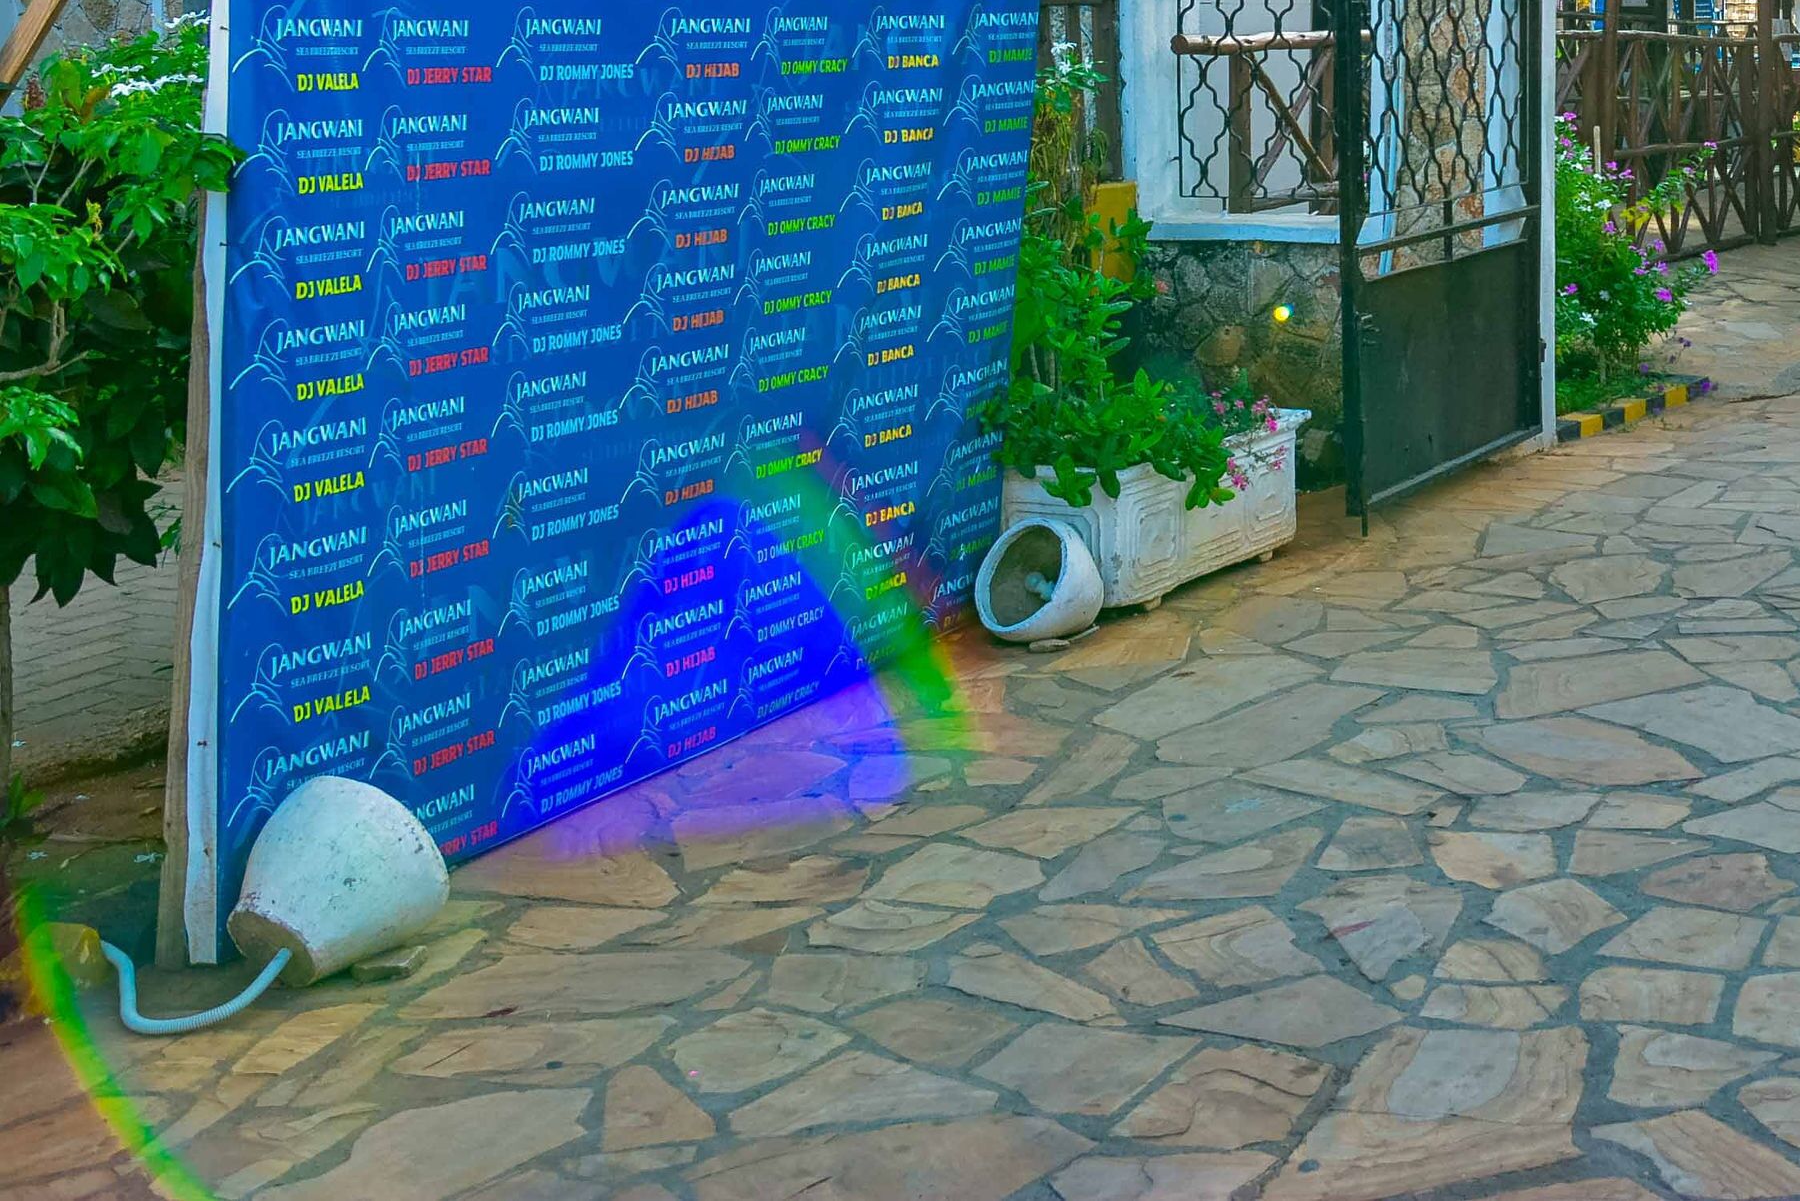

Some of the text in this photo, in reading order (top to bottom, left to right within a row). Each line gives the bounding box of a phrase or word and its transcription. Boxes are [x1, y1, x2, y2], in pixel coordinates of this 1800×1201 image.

[393, 19, 469, 41] JANGWANI
[876, 14, 945, 32] JANGWANI
[888, 54, 940, 69] DJ BANCA
[407, 66, 492, 85] DJ JERRY STAR
[767, 94, 823, 114] JANGWANI
[524, 107, 599, 130] JANGWANI
[775, 136, 840, 154] DJ OMMY CRACY
[540, 150, 633, 171] DJ ROMMY JONES
[657, 264, 734, 293] JANGWANI
[673, 310, 724, 331] DJ HIJAB
[272, 631, 370, 680] JANGWANI
[294, 686, 370, 722] DJ VALELA
